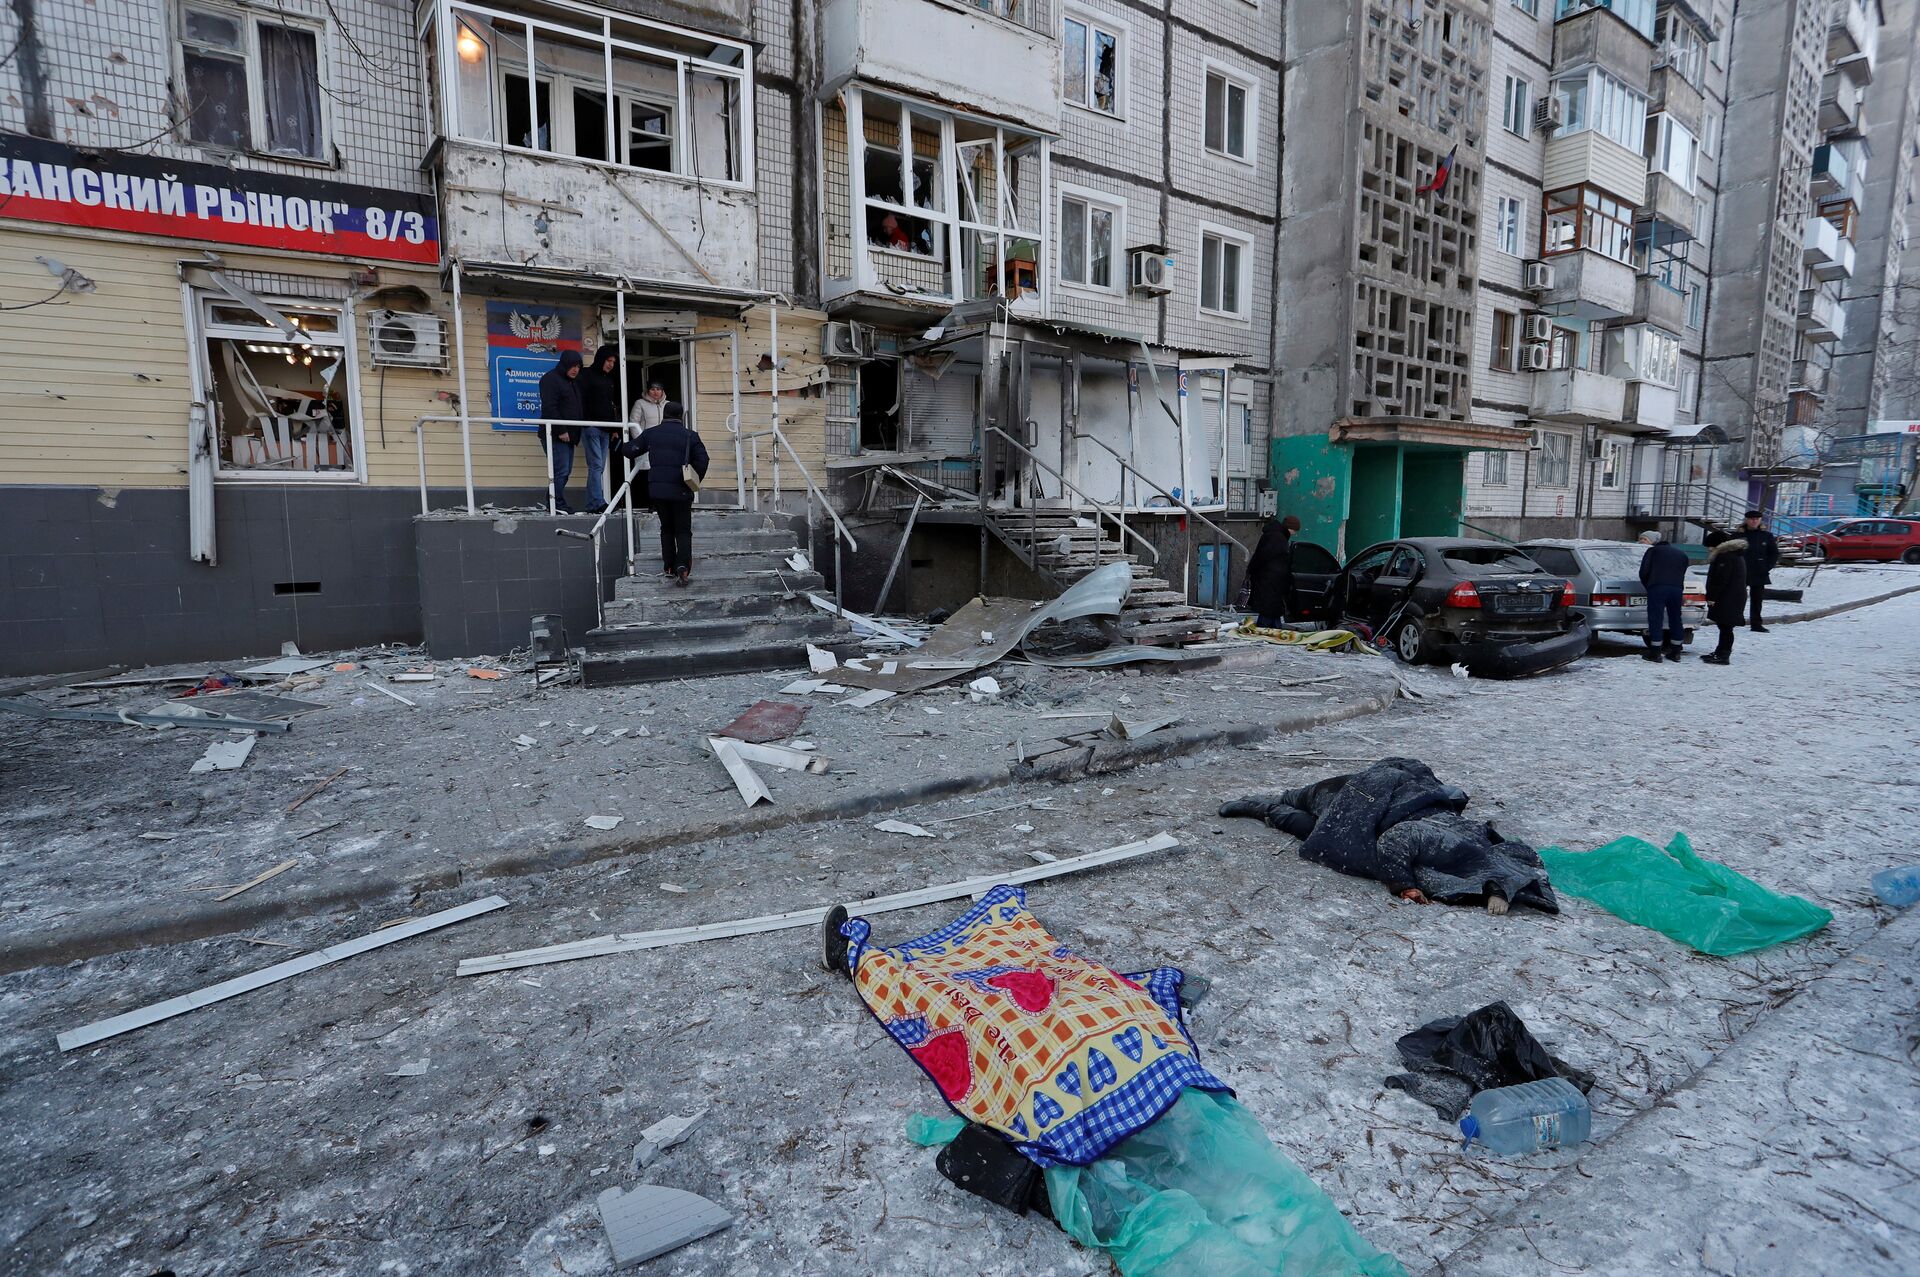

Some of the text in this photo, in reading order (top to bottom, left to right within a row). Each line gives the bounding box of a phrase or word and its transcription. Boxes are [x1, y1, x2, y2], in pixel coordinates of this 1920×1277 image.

[194, 183, 349, 235] РЫНОК"
[365, 206, 426, 245] 8/3
[944, 988, 984, 1023] Best
[988, 1026, 1018, 1071] The
